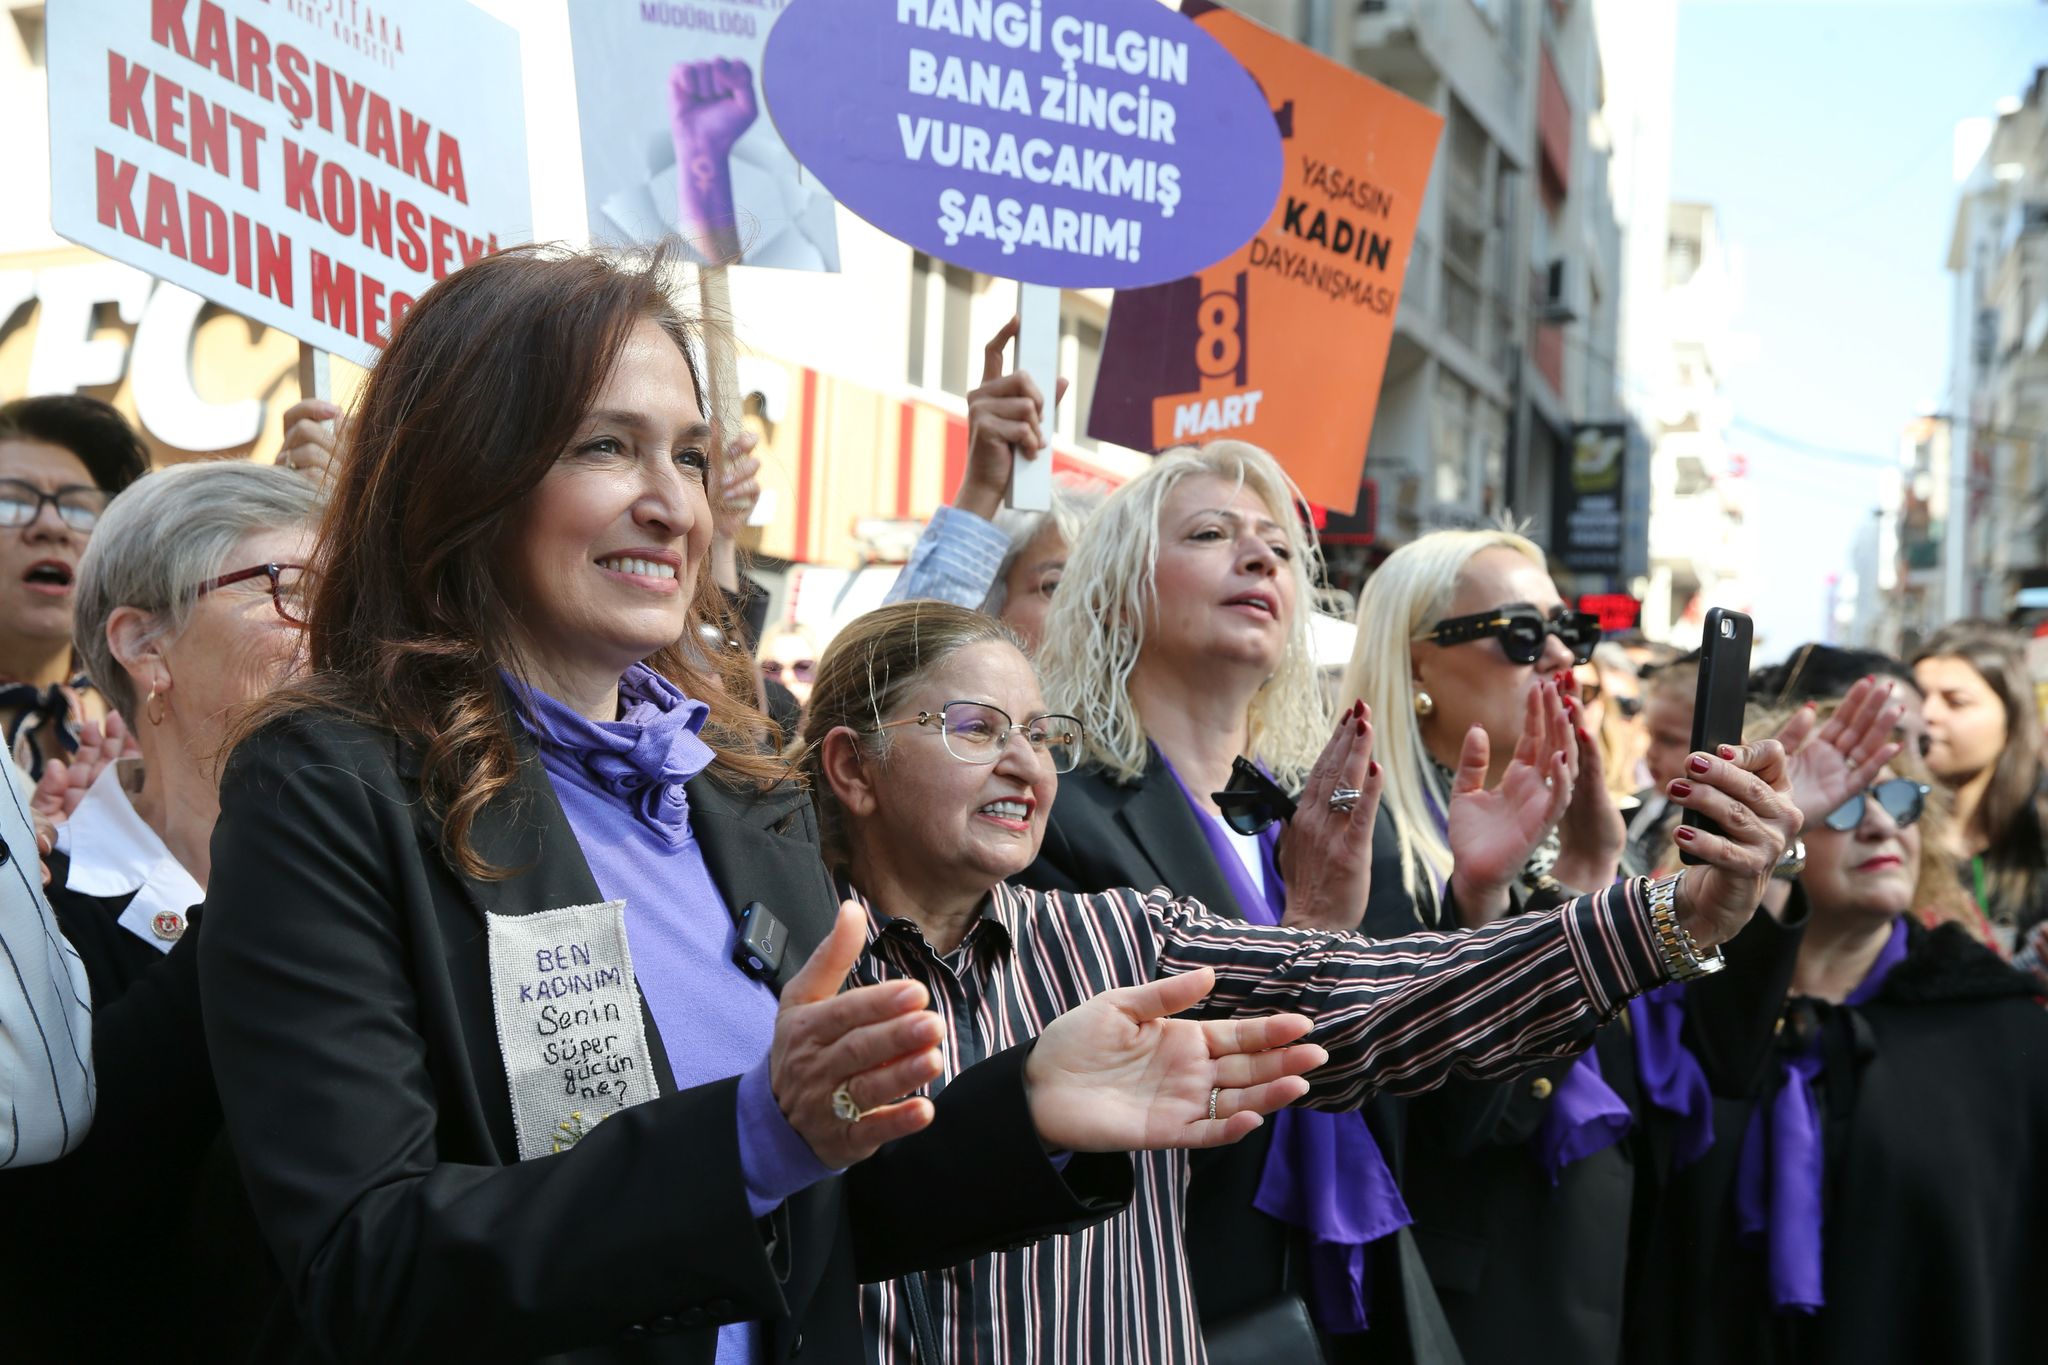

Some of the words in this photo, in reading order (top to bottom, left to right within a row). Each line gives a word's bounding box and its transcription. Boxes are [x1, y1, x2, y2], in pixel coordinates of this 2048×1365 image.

[896, 0, 1042, 53] HANGİ
[1050, 14, 1189, 86] ÇILGIN
[107, 48, 267, 193] KENT
[151, 0, 469, 206] KARŞIYAKA
[908, 48, 1033, 116] BANA
[1040, 69, 1177, 145] ZİNCİR
[896, 113, 1182, 218] VURACAKMIŞ
[1302, 154, 1393, 220] YAŞASIN
[94, 145, 295, 309] KADIN
[937, 188, 1143, 264] ŞAŞARIM!
[1282, 195, 1391, 273] KADIN
[1249, 236, 1395, 318] DAYANIŞMASI
[1195, 292, 1241, 378] 8
[1172, 390, 1263, 440] MART
[519, 966, 622, 1003] KADINIM
[536, 941, 591, 973] BEN
[537, 999, 620, 1036] Senin
[564, 1054, 634, 1095] gücün
[581, 1079, 629, 1107] ne?
